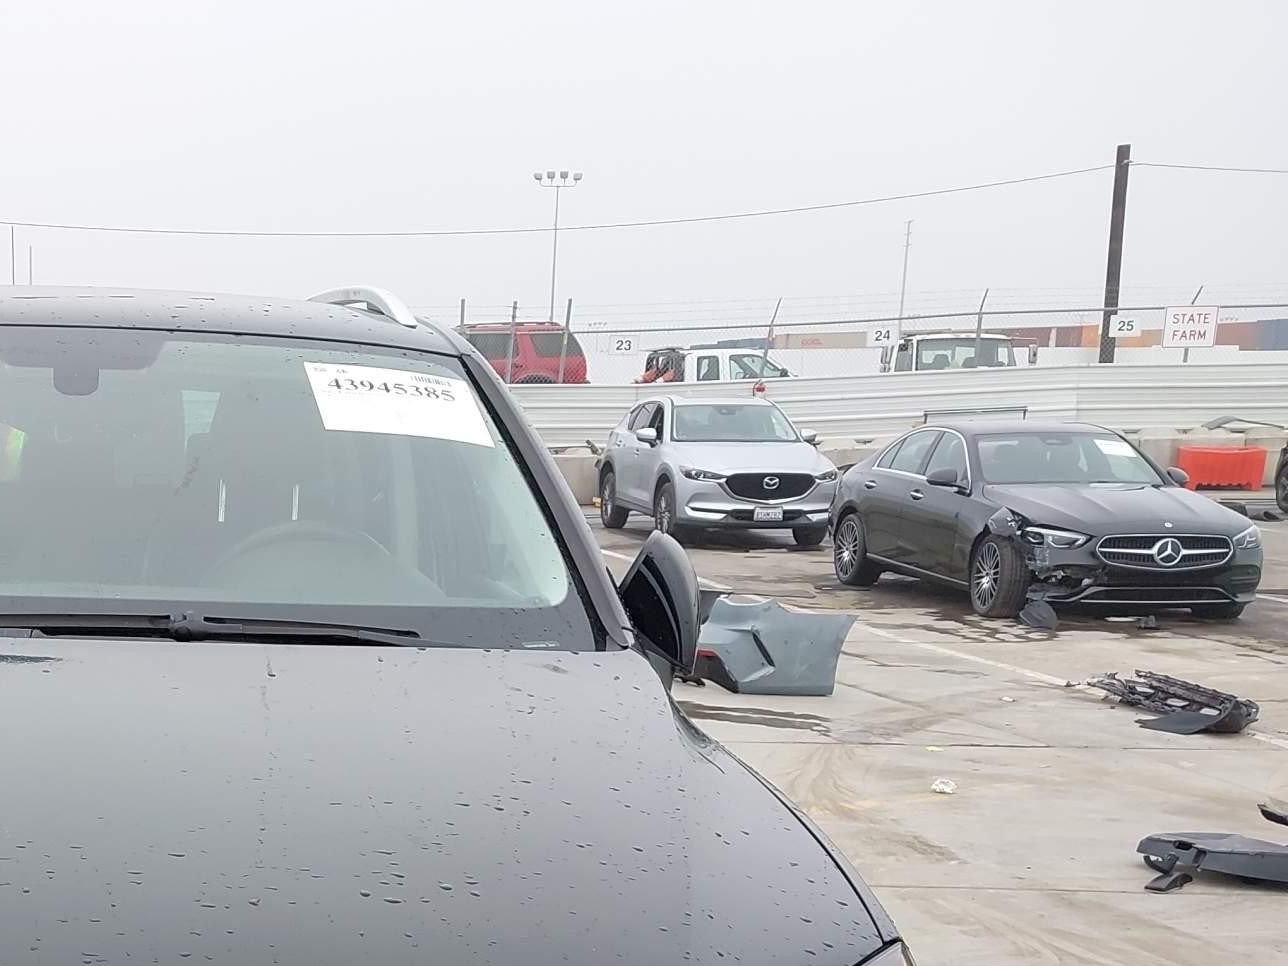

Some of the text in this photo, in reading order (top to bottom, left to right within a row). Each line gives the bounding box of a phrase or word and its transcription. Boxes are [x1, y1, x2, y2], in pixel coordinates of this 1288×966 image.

[1172, 312, 1211, 325] STATE
[1118, 320, 1134, 331] 25
[875, 329, 890, 341] 24
[1172, 329, 1207, 341] FARM
[615, 339, 632, 351] 23
[327, 377, 456, 402] 43945385
